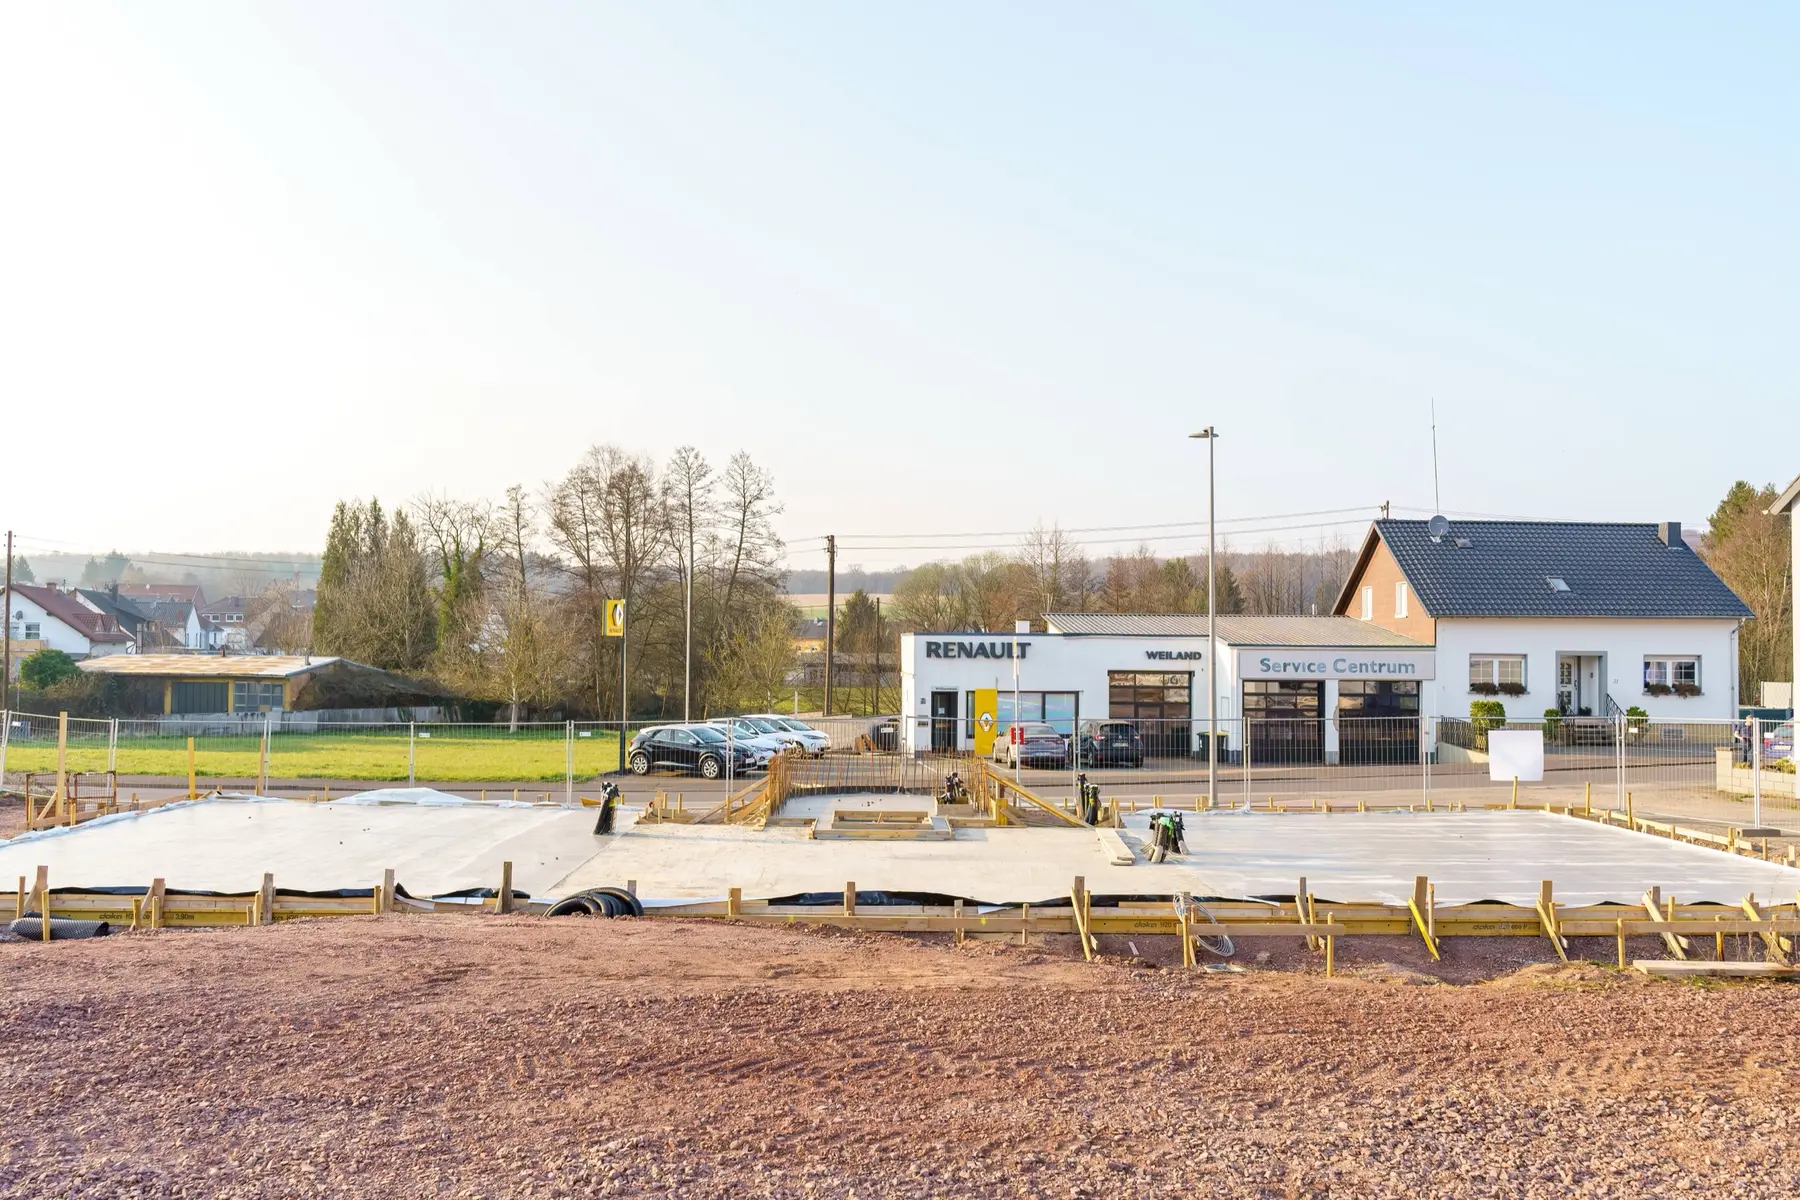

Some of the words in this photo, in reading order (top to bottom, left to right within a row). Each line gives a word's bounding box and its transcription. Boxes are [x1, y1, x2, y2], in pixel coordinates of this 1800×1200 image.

[926, 641, 1031, 659] RENAULT
[1145, 651, 1202, 660] WEILAND
[1260, 657, 1327, 673] Service
[1333, 658, 1415, 674] Centrum
